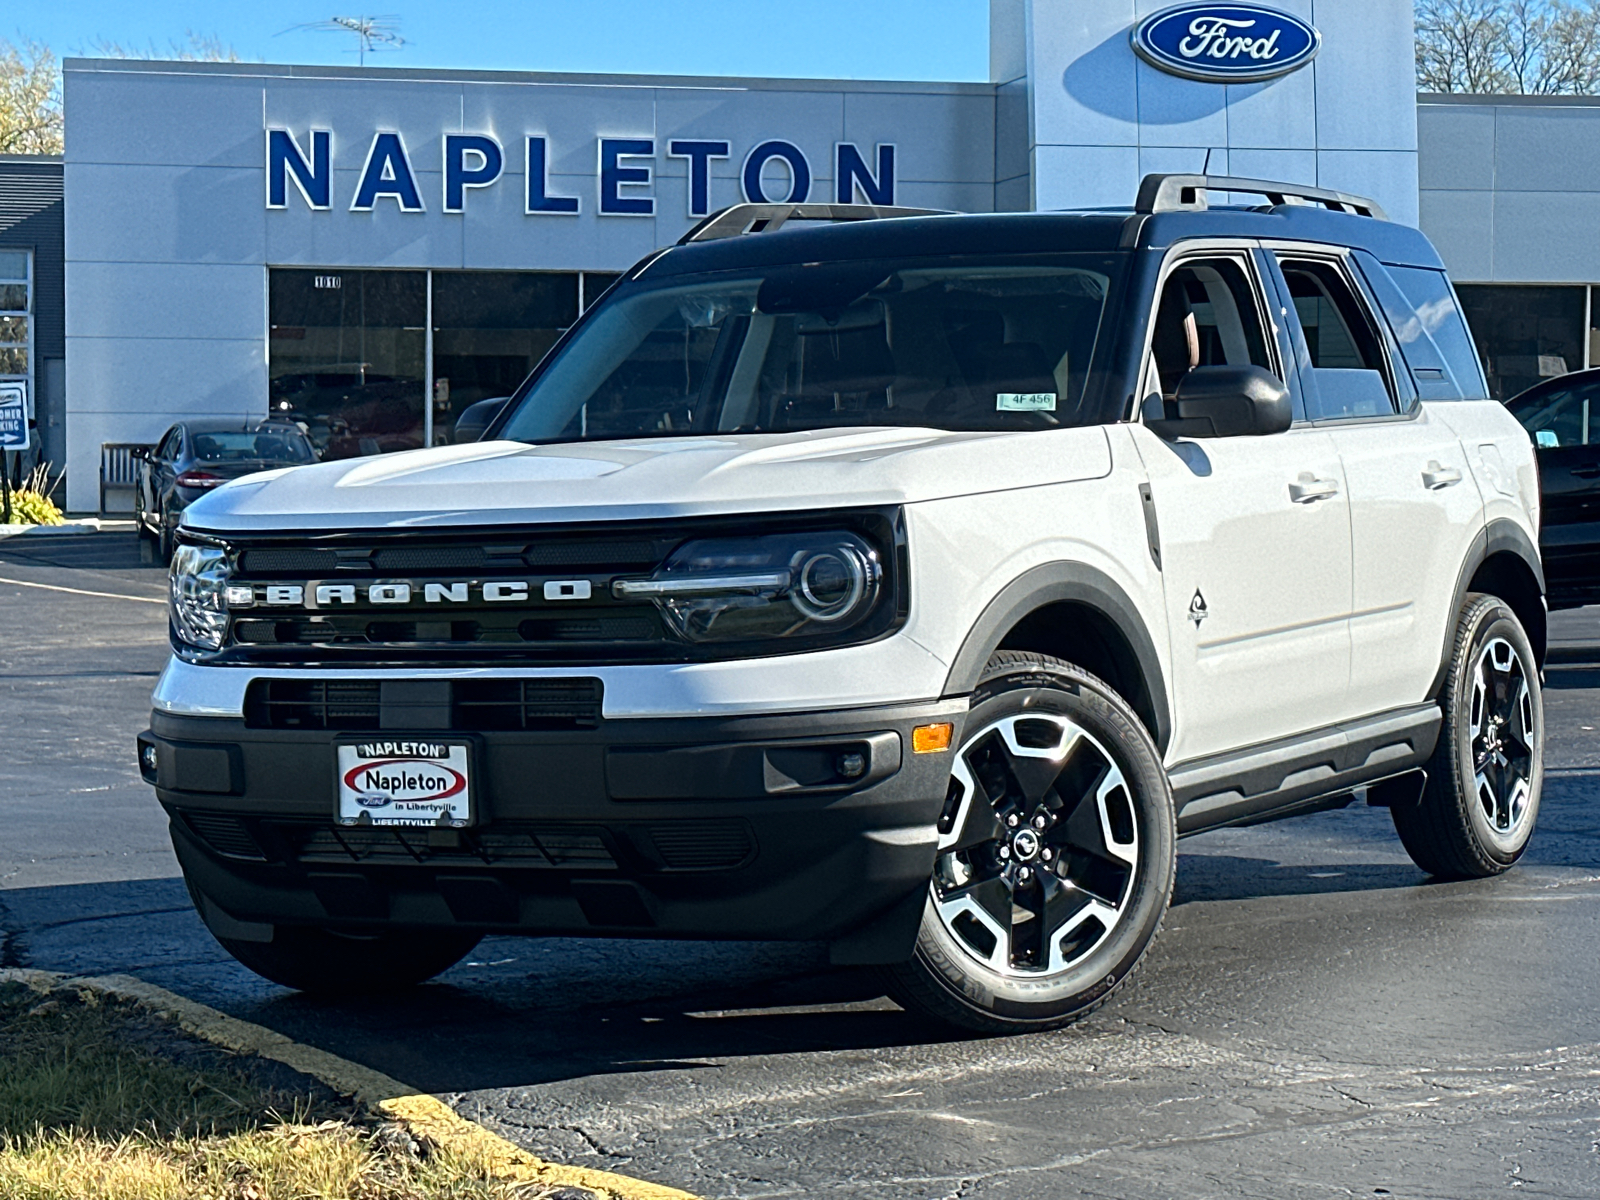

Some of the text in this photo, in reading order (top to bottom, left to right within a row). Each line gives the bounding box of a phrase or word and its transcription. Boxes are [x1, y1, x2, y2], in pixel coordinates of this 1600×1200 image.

[1178, 16, 1281, 60] Ford
[264, 127, 899, 217] NAPLETON
[315, 275, 342, 289] 1010
[1029, 394, 1051, 404] 456
[266, 579, 593, 605] BRONCO
[364, 742, 439, 757] NAPLETON
[365, 770, 447, 794] Napleton
[406, 803, 457, 812] Libertyville
